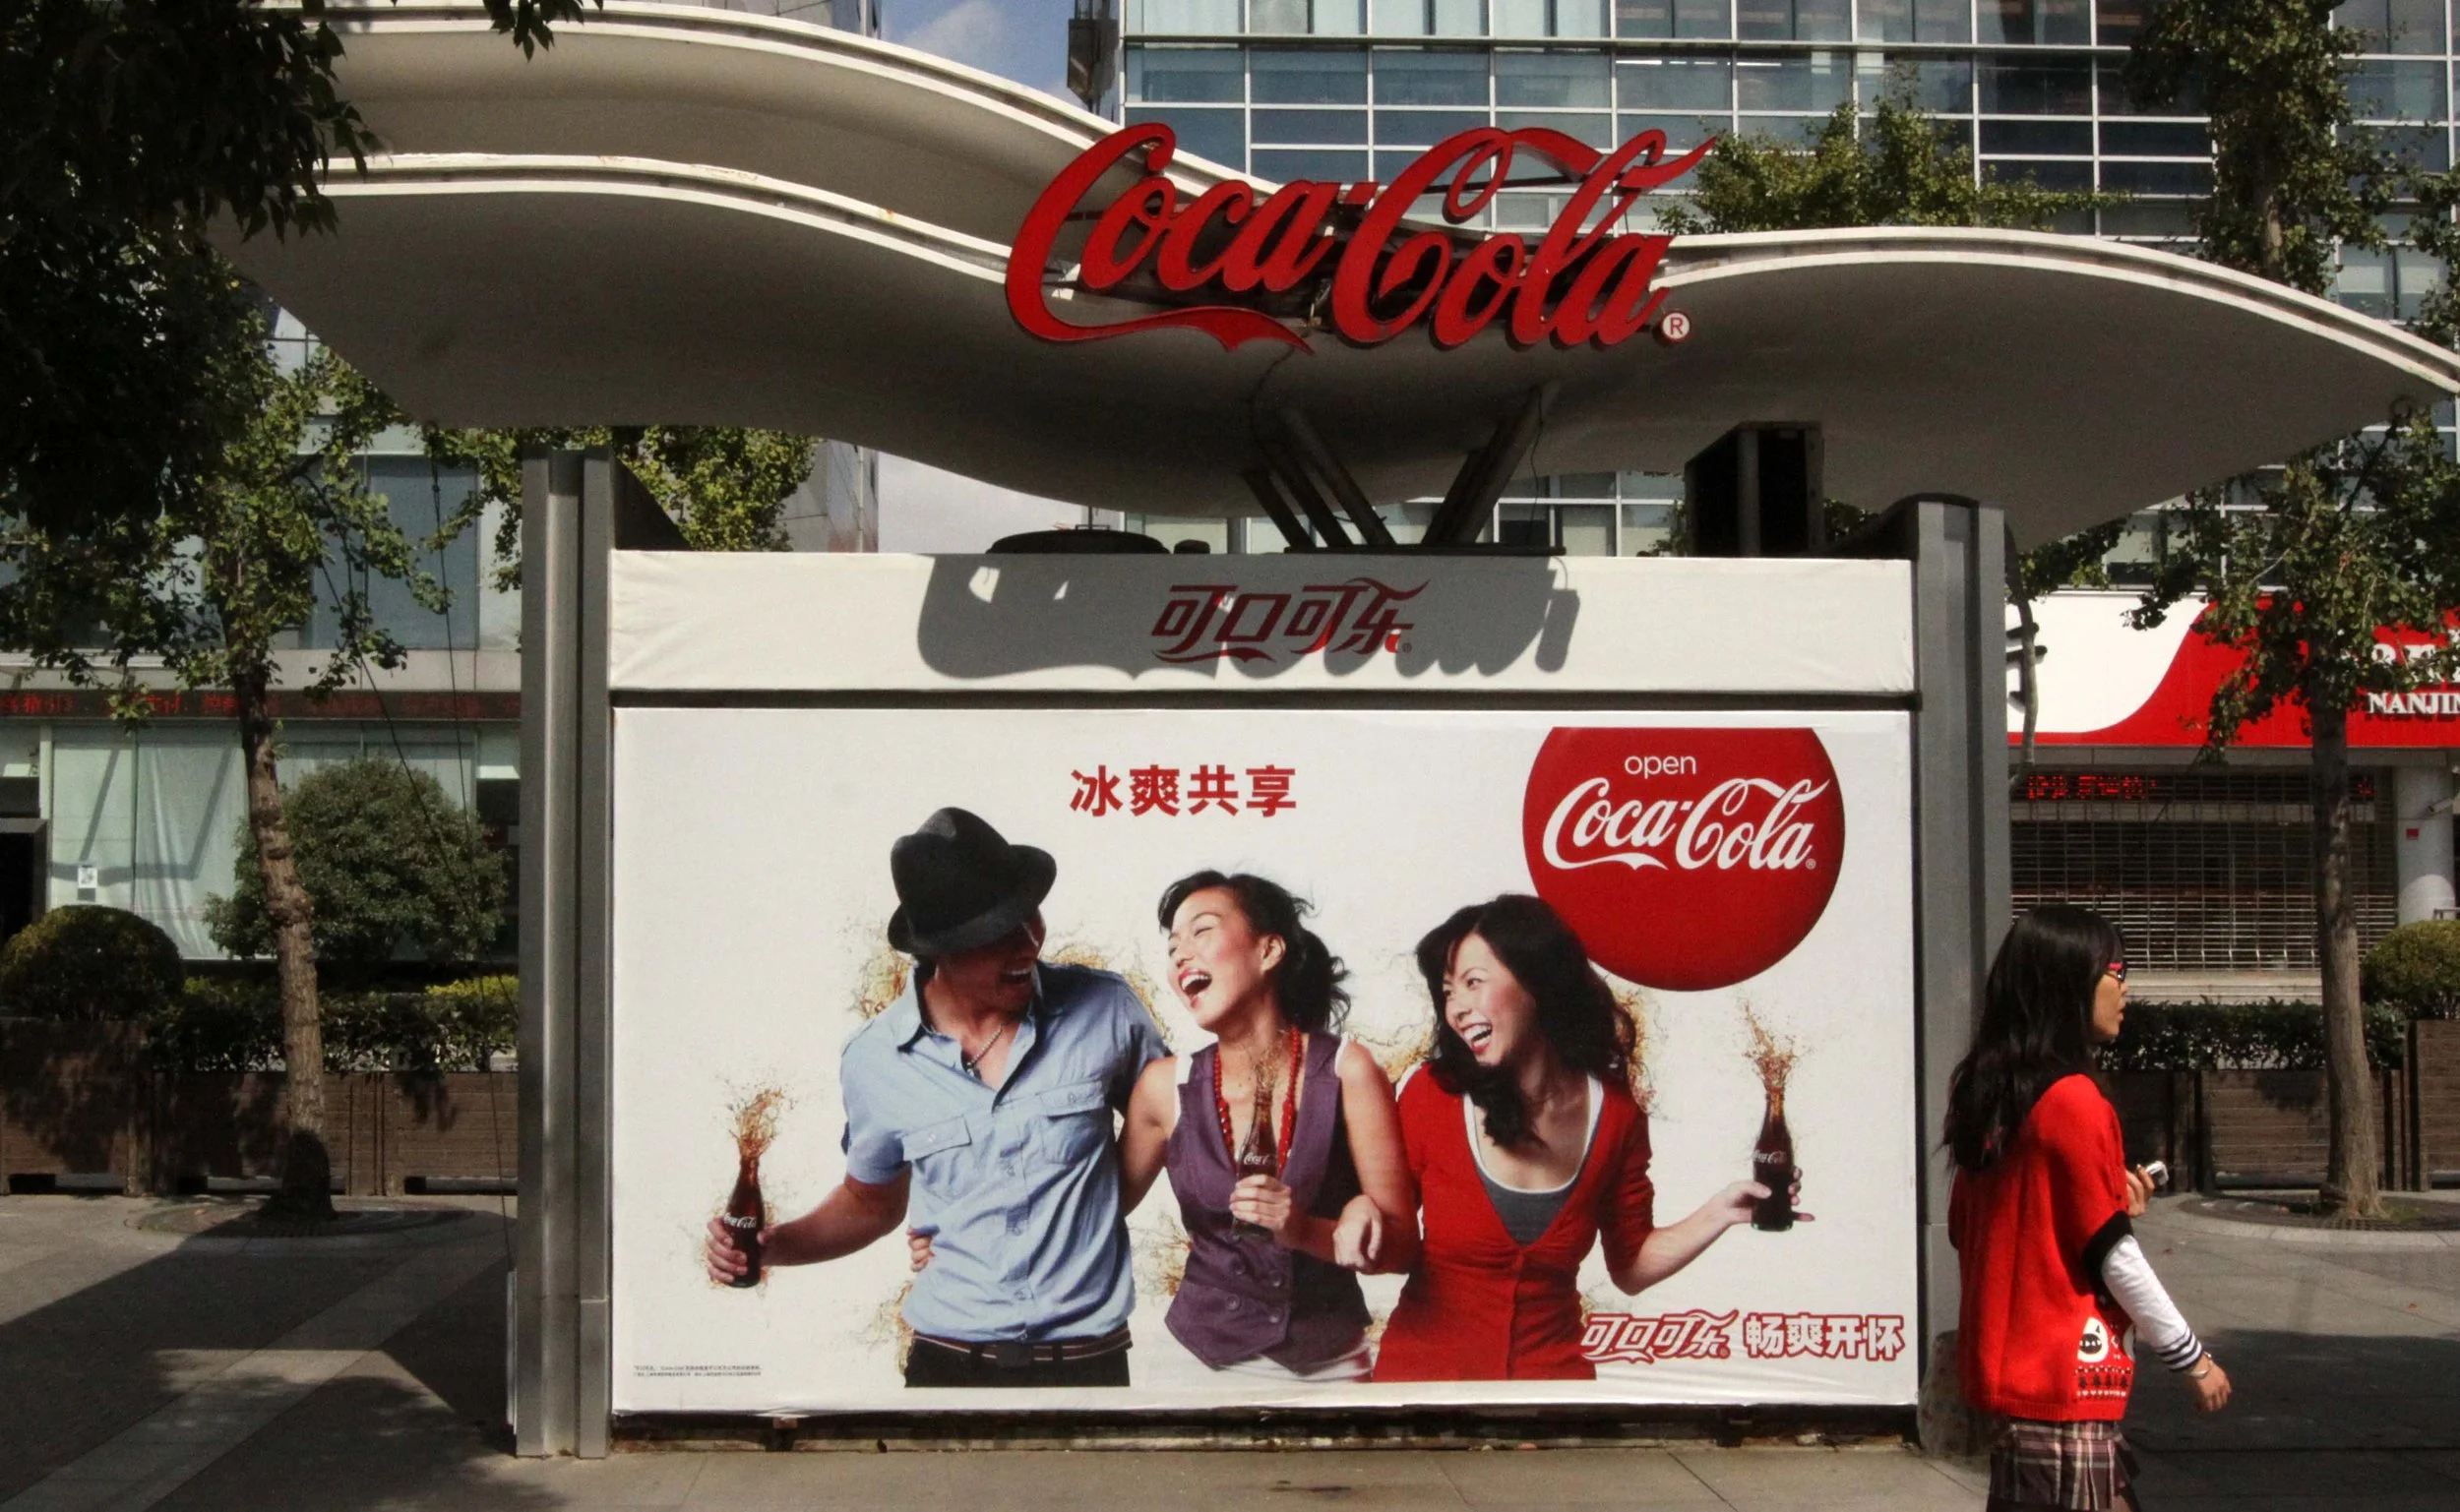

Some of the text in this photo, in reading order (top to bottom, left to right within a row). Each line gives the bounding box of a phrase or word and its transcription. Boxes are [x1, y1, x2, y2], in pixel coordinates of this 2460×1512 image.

[1005, 122, 1716, 354] Coca-Cola
[1150, 576, 1431, 663] 可口可乐
[1069, 764, 1297, 817] 冰爽共享
[1624, 755, 1697, 779] open
[1542, 777, 1831, 871] Coca-Cola
[1579, 1308, 1905, 1364] 可口可乐 畅爽开怀
